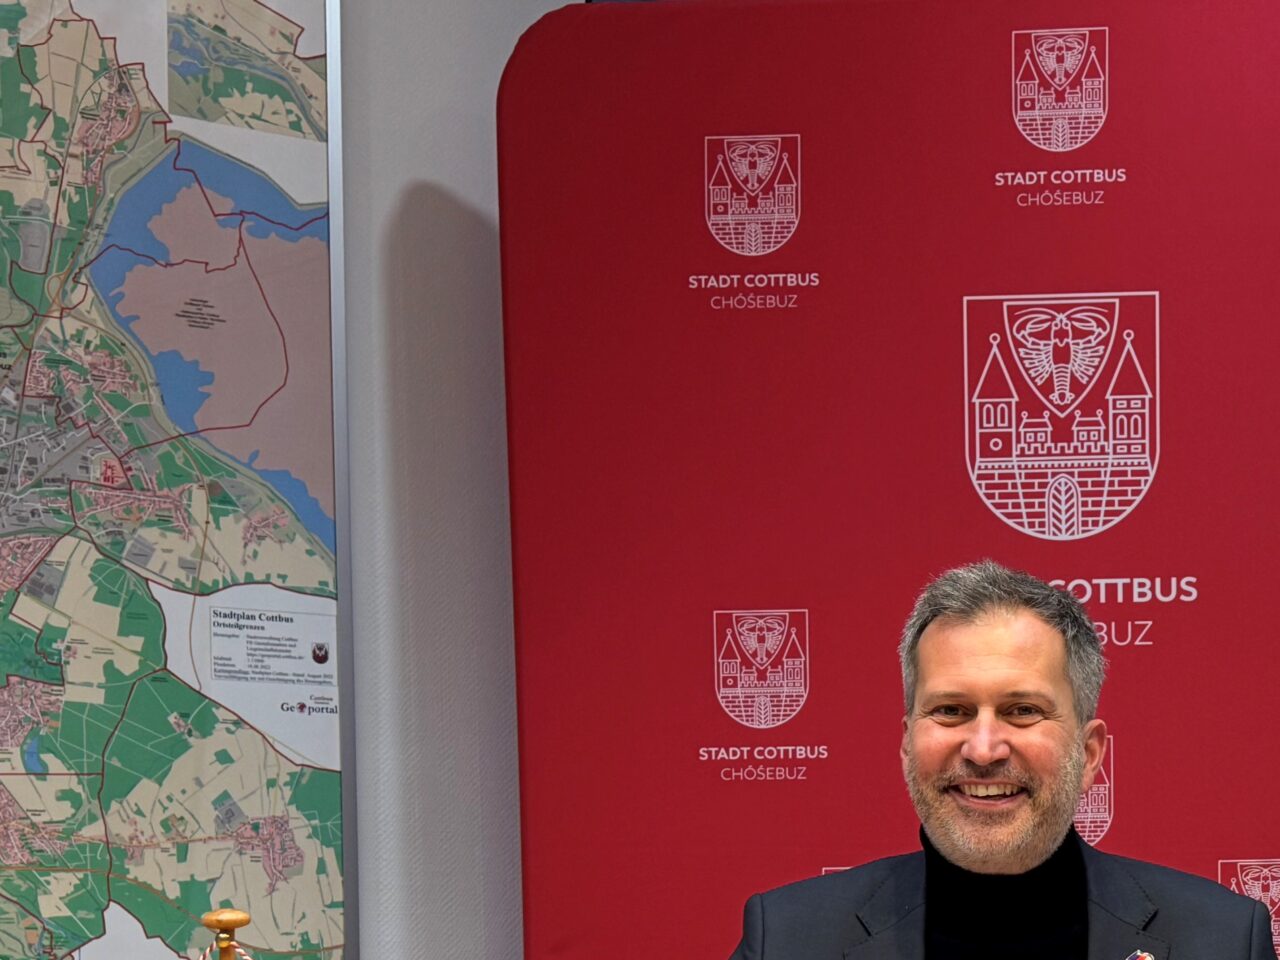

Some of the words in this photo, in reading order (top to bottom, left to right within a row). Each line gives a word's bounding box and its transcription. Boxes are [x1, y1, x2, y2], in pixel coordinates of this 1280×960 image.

[995, 171, 1048, 186] STADT
[1050, 168, 1127, 185] COTTBUS
[688, 275, 741, 289] STADT
[744, 272, 820, 288] COTTBUS
[212, 609, 256, 622] Stadtplan
[258, 612, 294, 624] Cottbus
[212, 620, 265, 632] Ortsteilgrenzen
[698, 746, 751, 761] STADT
[753, 745, 829, 760] COTTBUS
